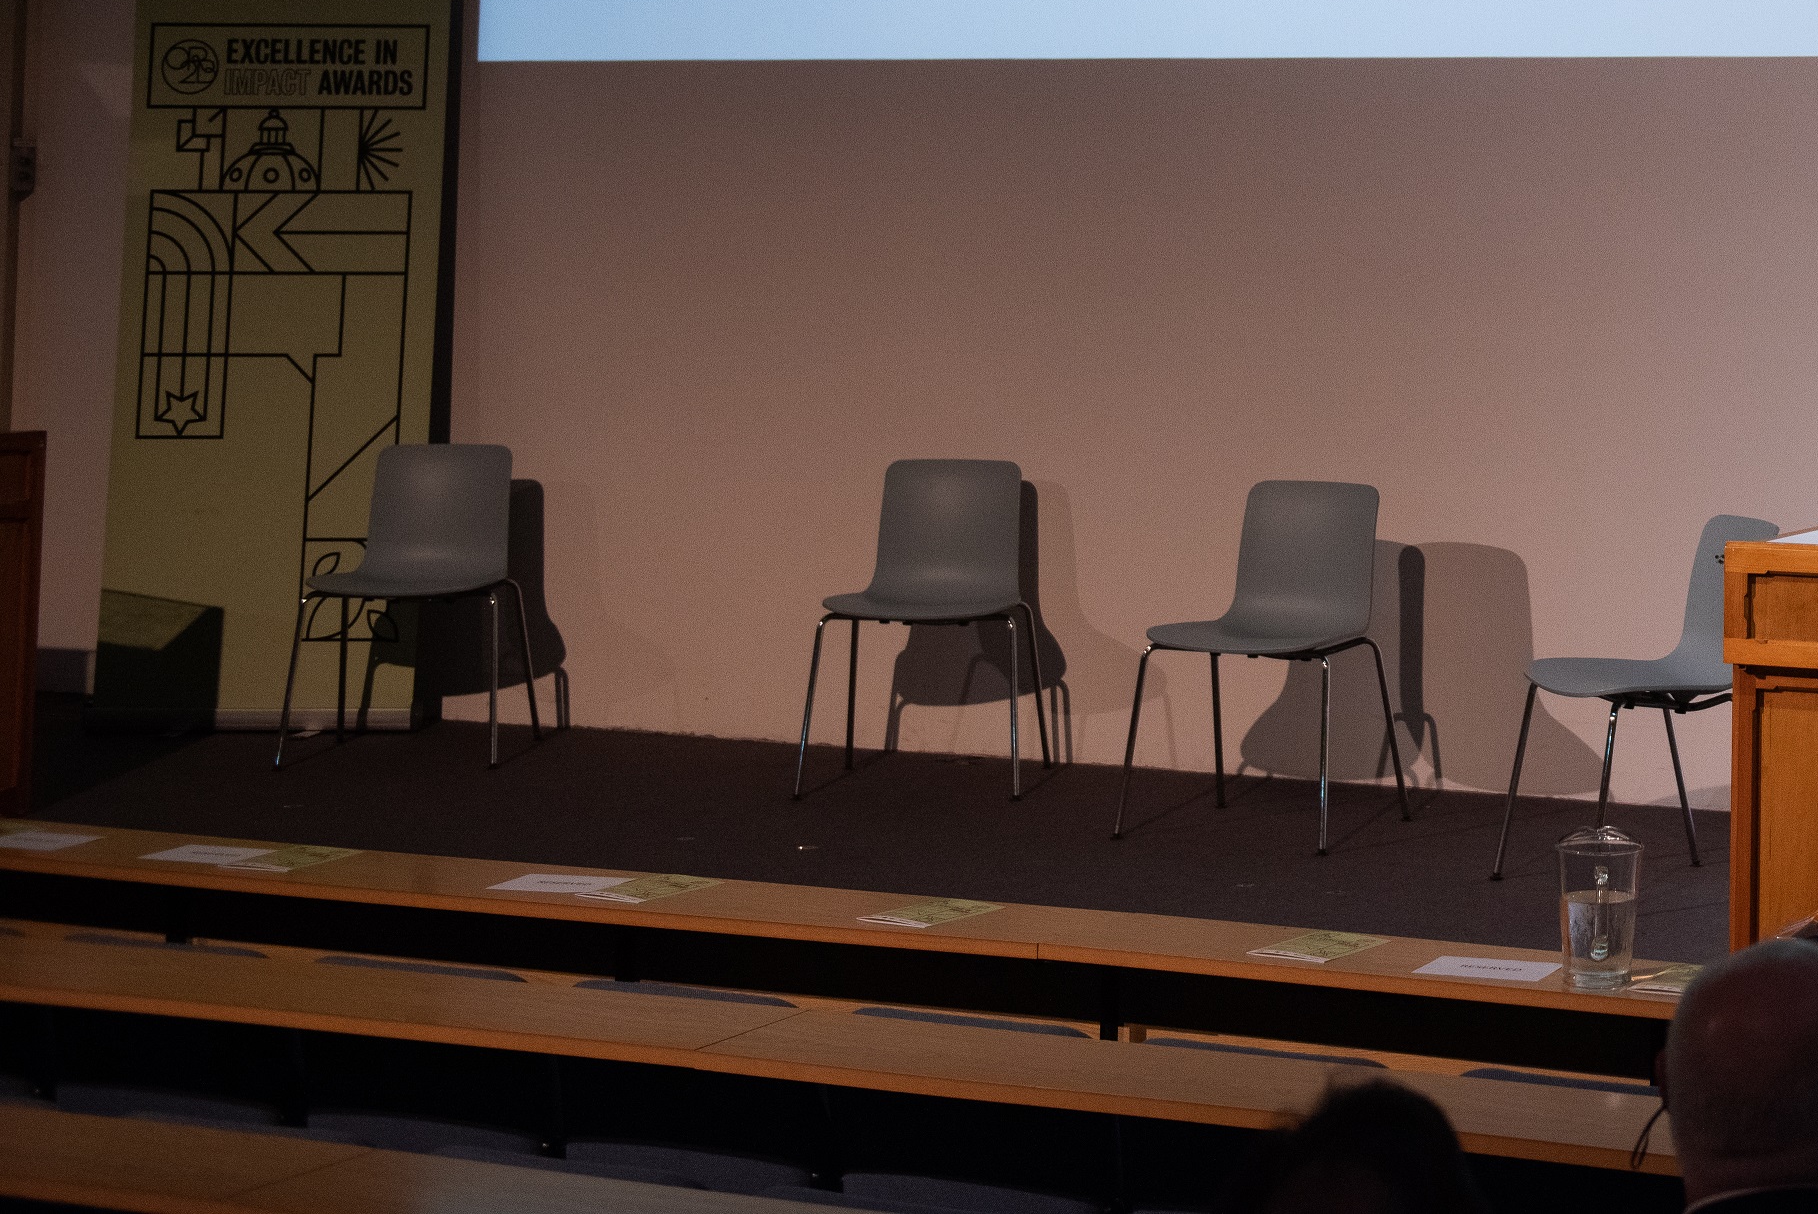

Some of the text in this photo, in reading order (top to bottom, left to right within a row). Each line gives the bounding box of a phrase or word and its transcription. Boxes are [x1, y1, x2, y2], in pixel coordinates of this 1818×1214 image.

[226, 38, 398, 65] EXCELLENCE IN
[223, 68, 413, 96] IMPACT AWARDS
